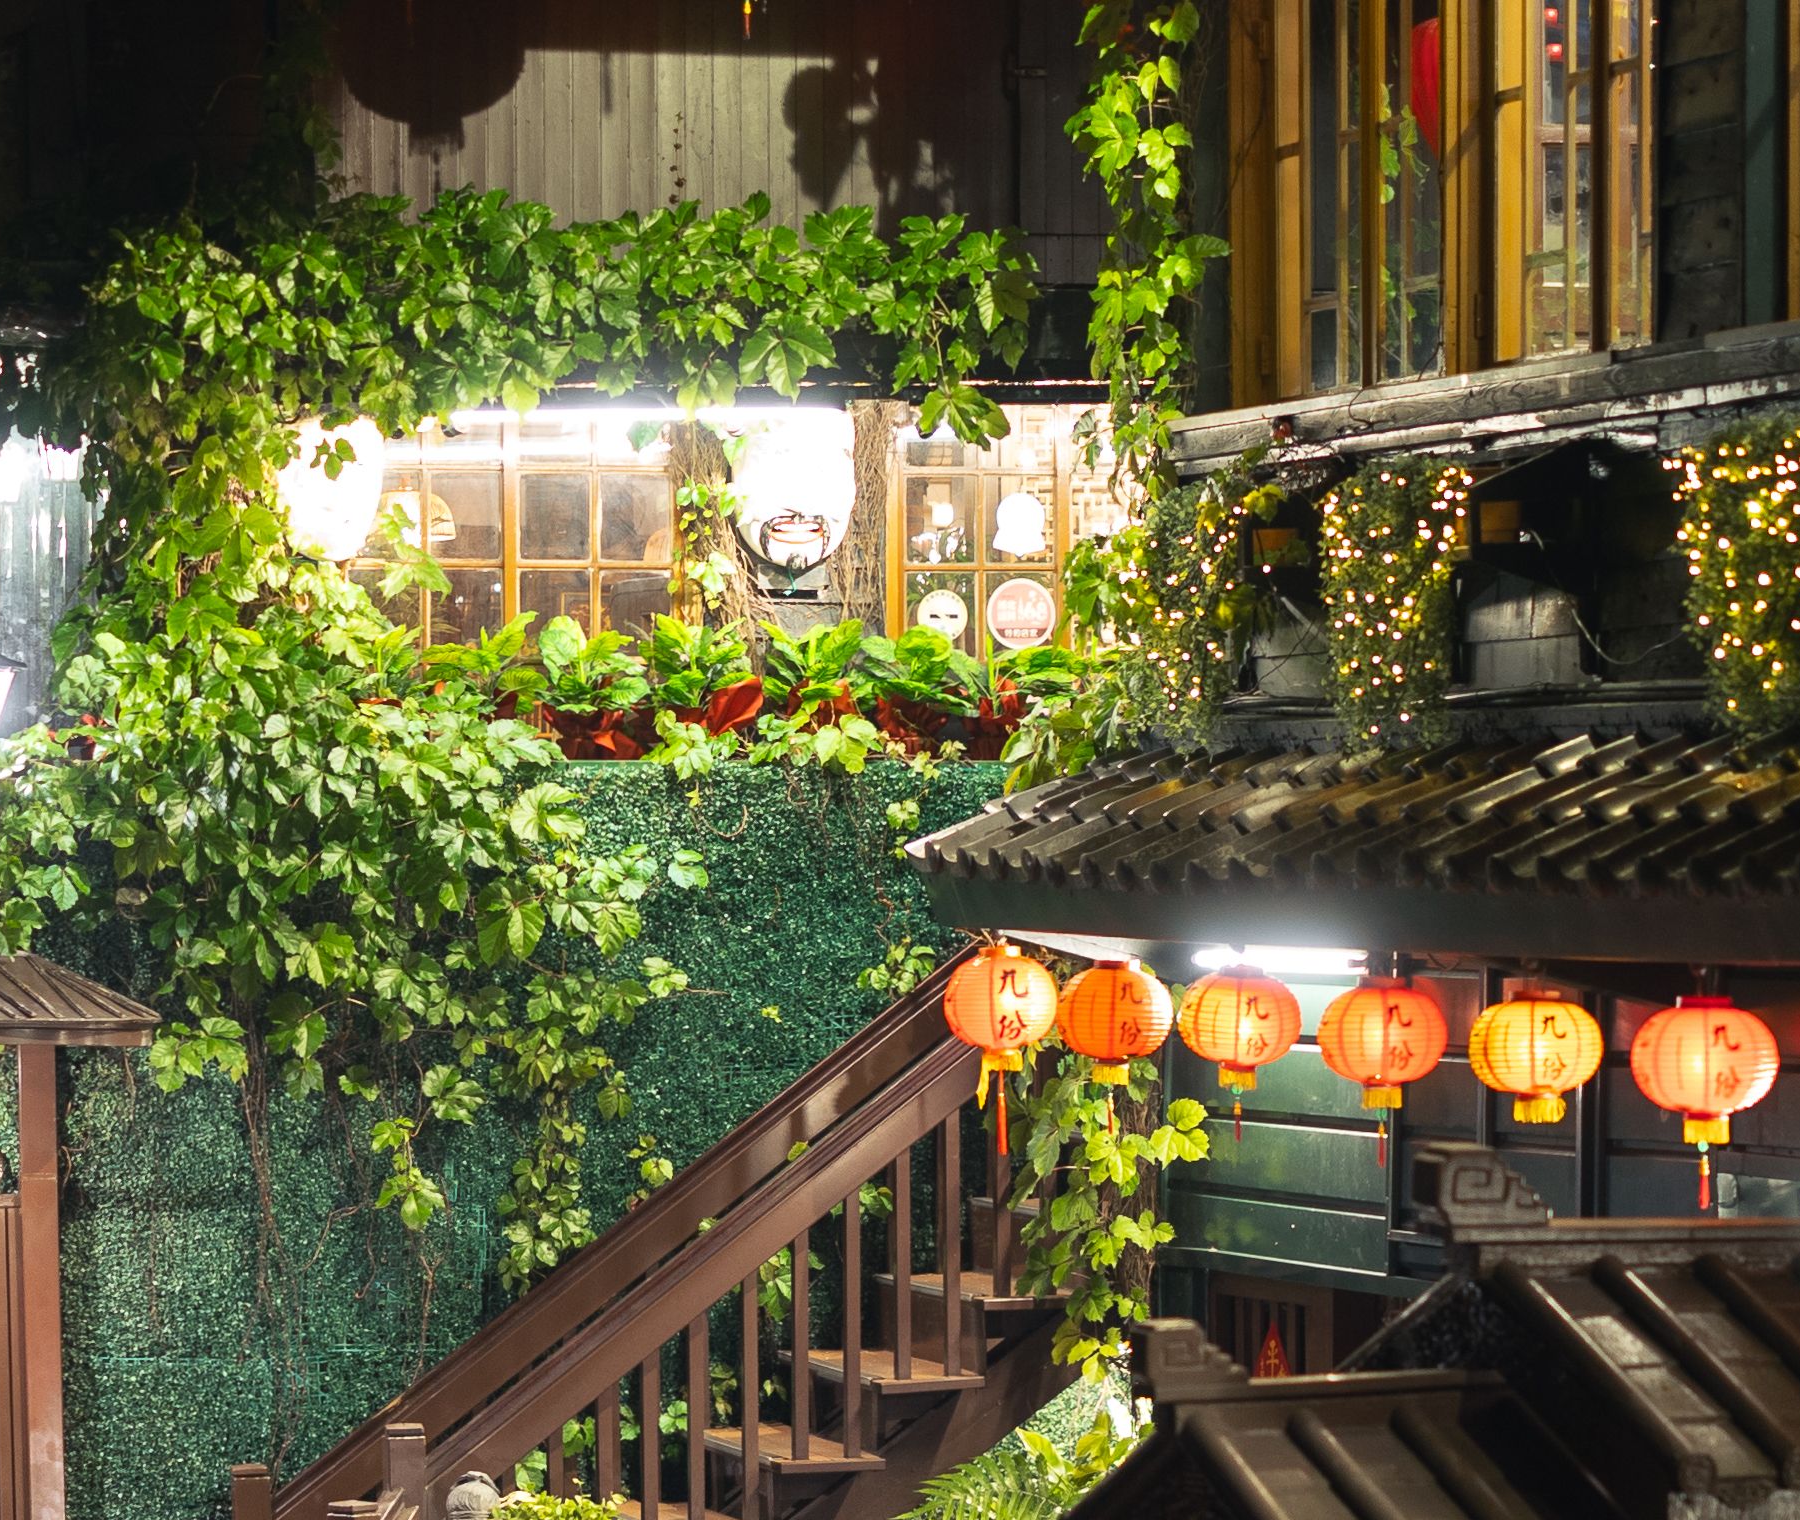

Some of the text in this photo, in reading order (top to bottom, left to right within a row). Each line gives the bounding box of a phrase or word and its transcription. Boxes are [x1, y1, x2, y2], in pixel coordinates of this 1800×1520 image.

[998, 968, 1029, 1040] 九份
[1120, 982, 1142, 1046] 九份
[1246, 996, 1269, 1057] 九份
[1388, 1005, 1414, 1070] 九份
[1542, 1016, 1567, 1080] 九份
[1712, 1025, 1740, 1099] 九份
